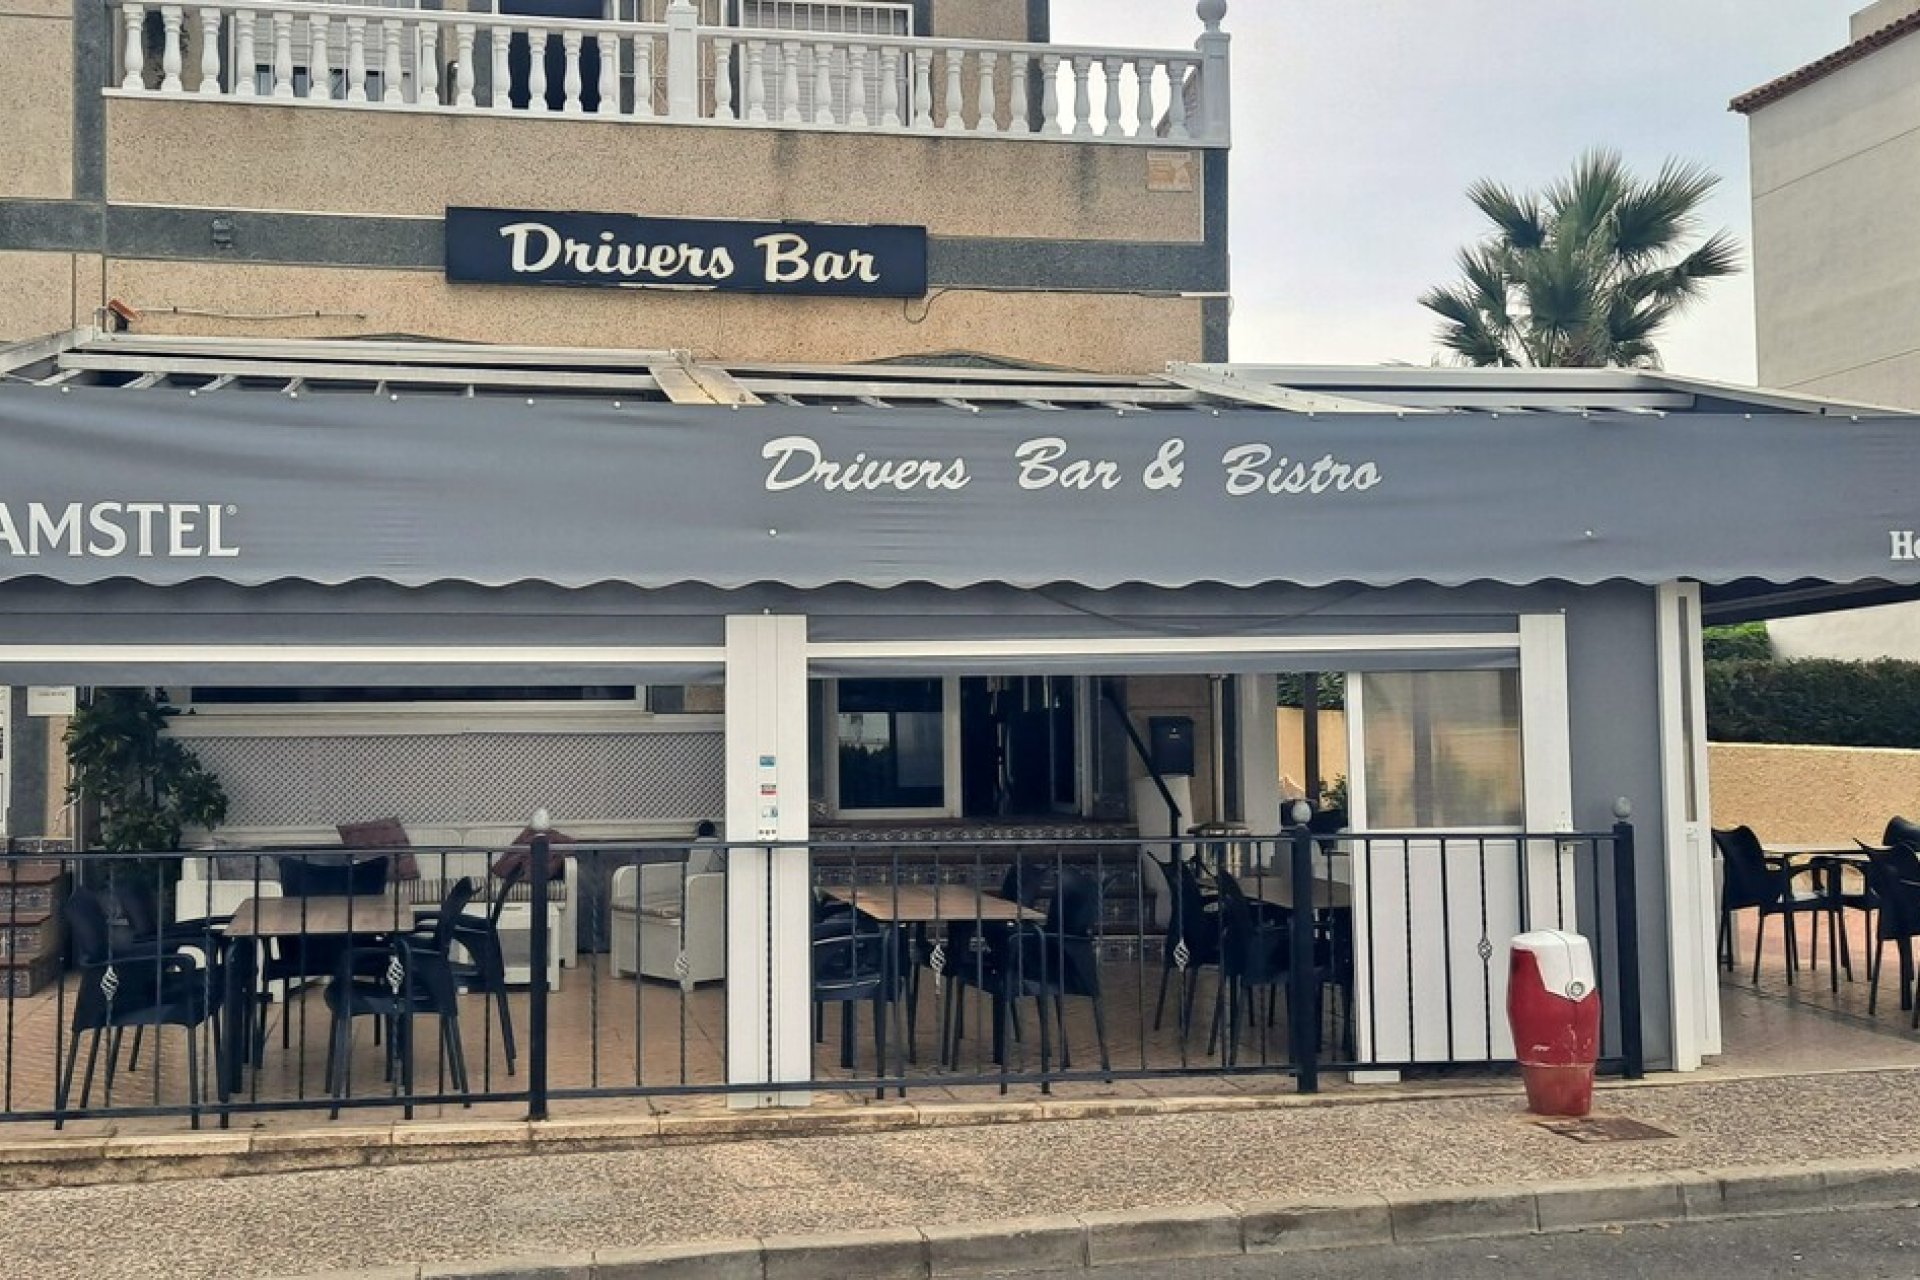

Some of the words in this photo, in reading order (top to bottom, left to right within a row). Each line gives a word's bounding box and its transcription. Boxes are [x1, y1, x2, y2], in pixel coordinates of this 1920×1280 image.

[499, 222, 734, 280] Drivers
[753, 232, 880, 283] Bar
[761, 436, 972, 492] Drivers
[1014, 437, 1122, 492] Bar
[1142, 438, 1186, 490] &
[1221, 443, 1383, 496] Bistro
